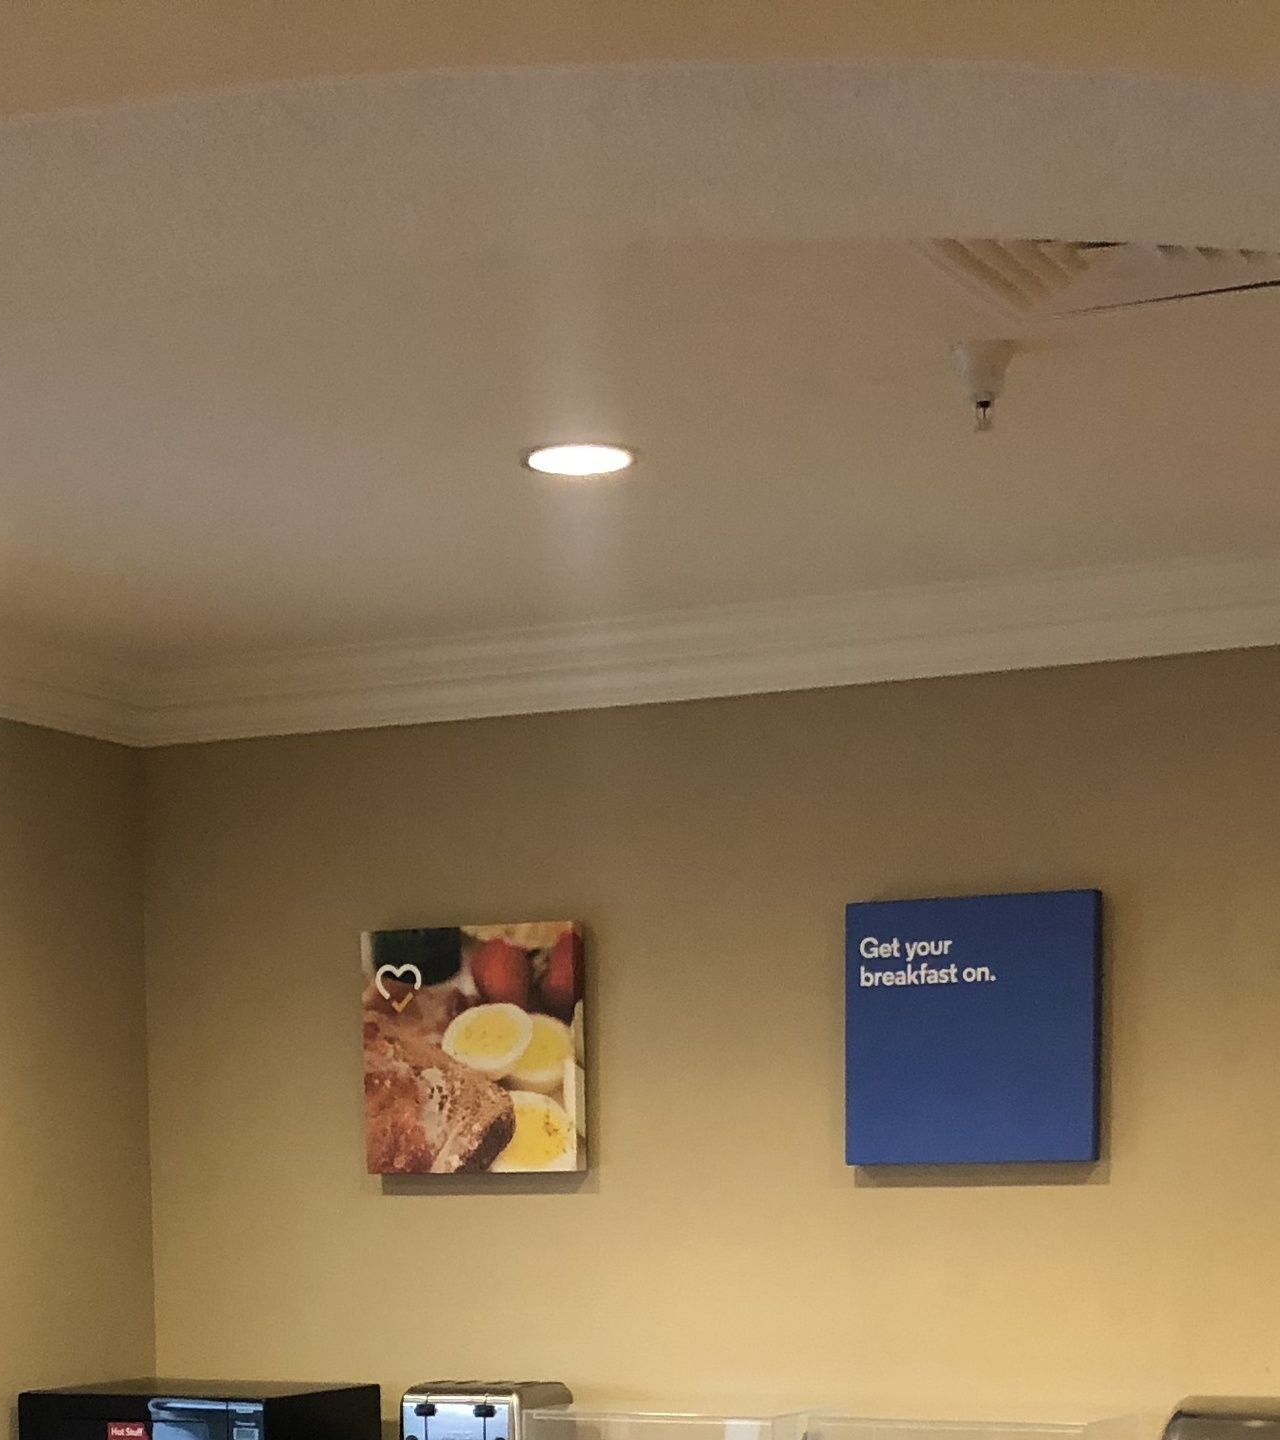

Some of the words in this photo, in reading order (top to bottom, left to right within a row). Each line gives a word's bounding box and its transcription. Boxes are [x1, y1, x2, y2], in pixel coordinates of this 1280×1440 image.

[859, 937, 900, 958] Get
[905, 939, 952, 962] your
[859, 963, 958, 987] breakfast
[962, 966, 997, 982] on.
